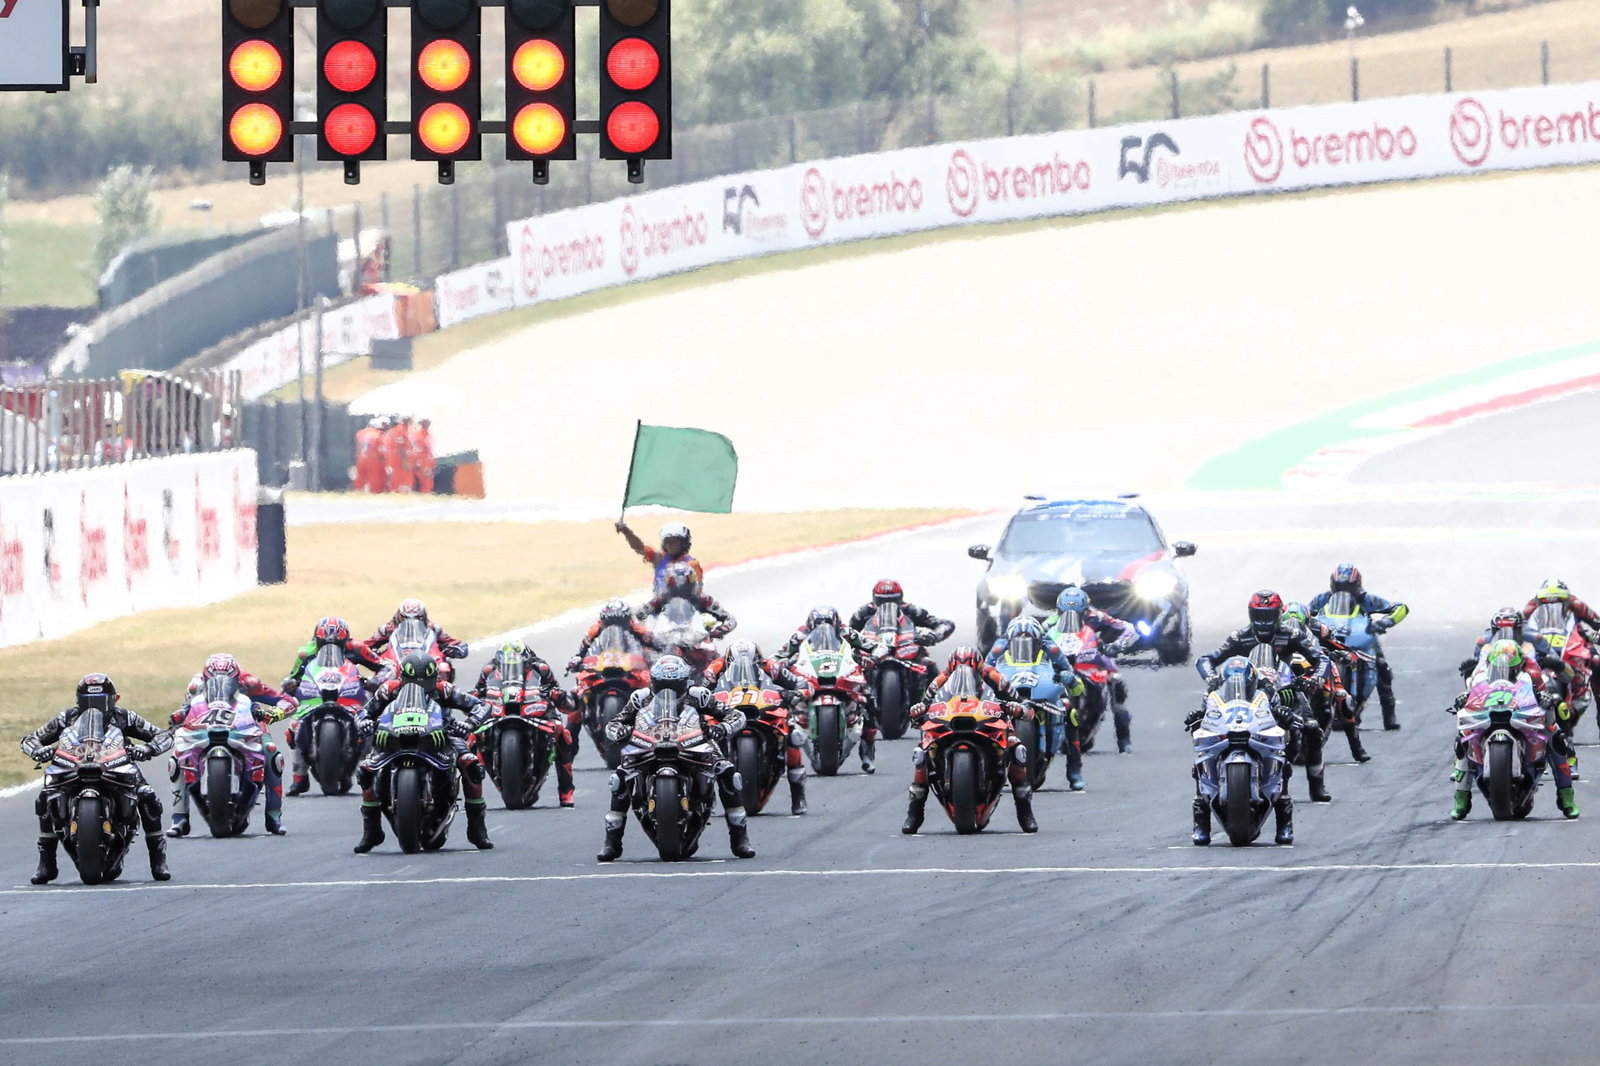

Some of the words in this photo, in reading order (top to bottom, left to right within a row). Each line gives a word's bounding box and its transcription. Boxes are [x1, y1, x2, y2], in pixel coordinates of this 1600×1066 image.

[1290, 121, 1417, 168] brembo
[982, 151, 1090, 201] brembo
[832, 170, 923, 221] brembo
[641, 205, 708, 257] brembo
[541, 230, 605, 278] brembo
[729, 689, 760, 705] 37
[1484, 690, 1513, 707] 21
[949, 699, 980, 714] 12
[1225, 706, 1254, 724] 73
[200, 708, 237, 726] 49
[631, 736, 653, 748] Lenovo
[680, 735, 704, 748] Lenovo
[53, 755, 76, 768] Lenovo
[104, 756, 127, 768] Lenovo
